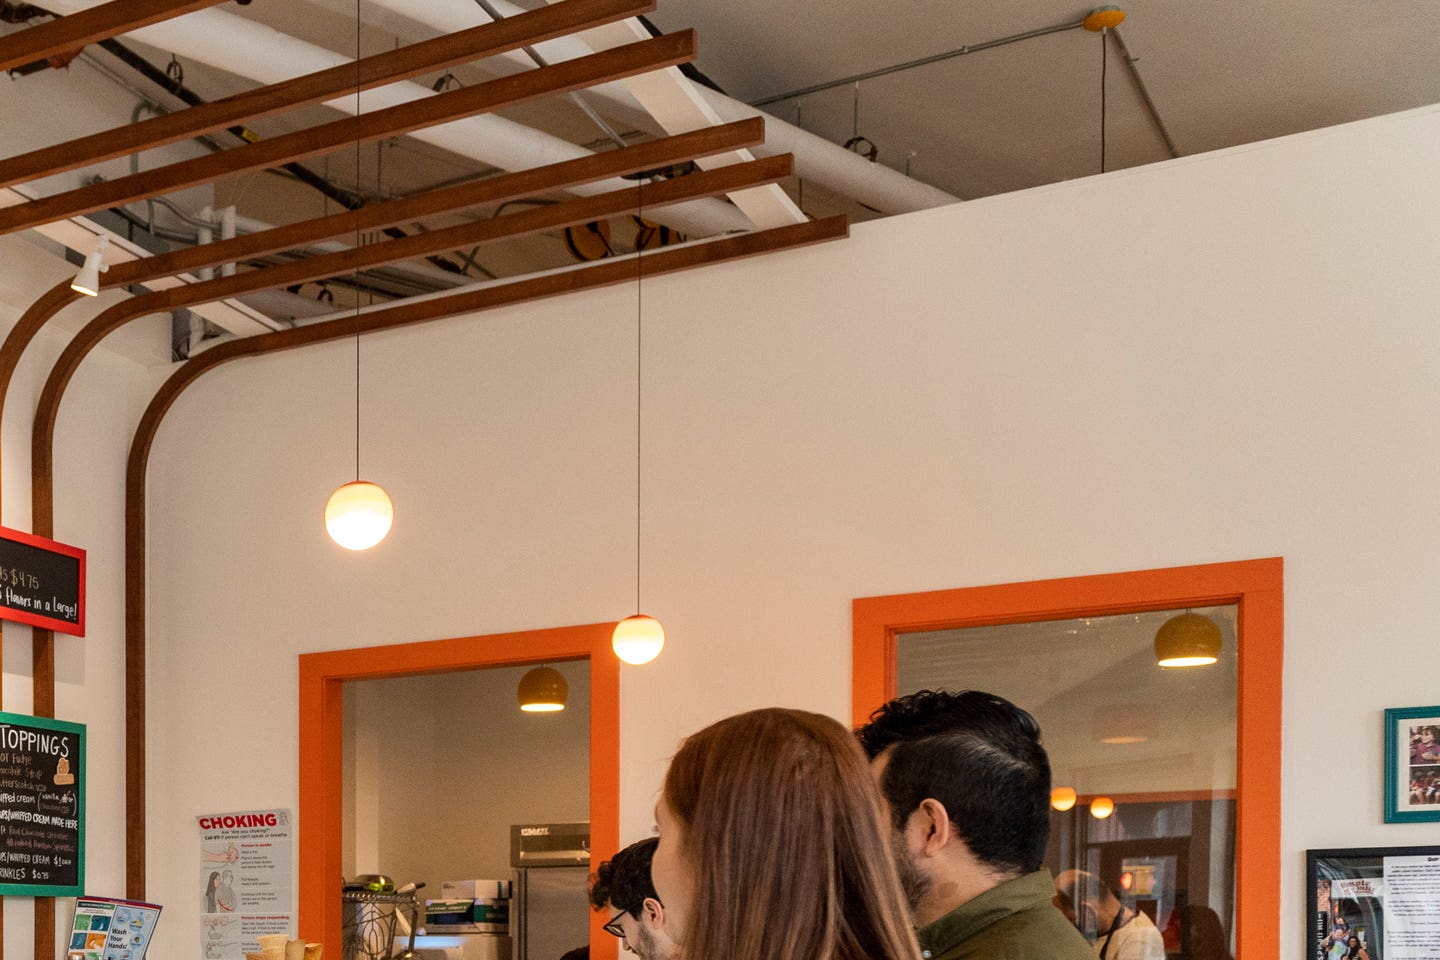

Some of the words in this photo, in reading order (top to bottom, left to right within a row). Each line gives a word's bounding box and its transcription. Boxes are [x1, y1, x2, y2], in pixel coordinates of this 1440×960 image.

[9, 568, 40, 589] $4.75
[5, 586, 32, 608] flavors
[33, 593, 42, 610] in
[44, 600, 51, 612] a
[53, 598, 78, 621] Large!
[199, 813, 277, 830] CHOKING
